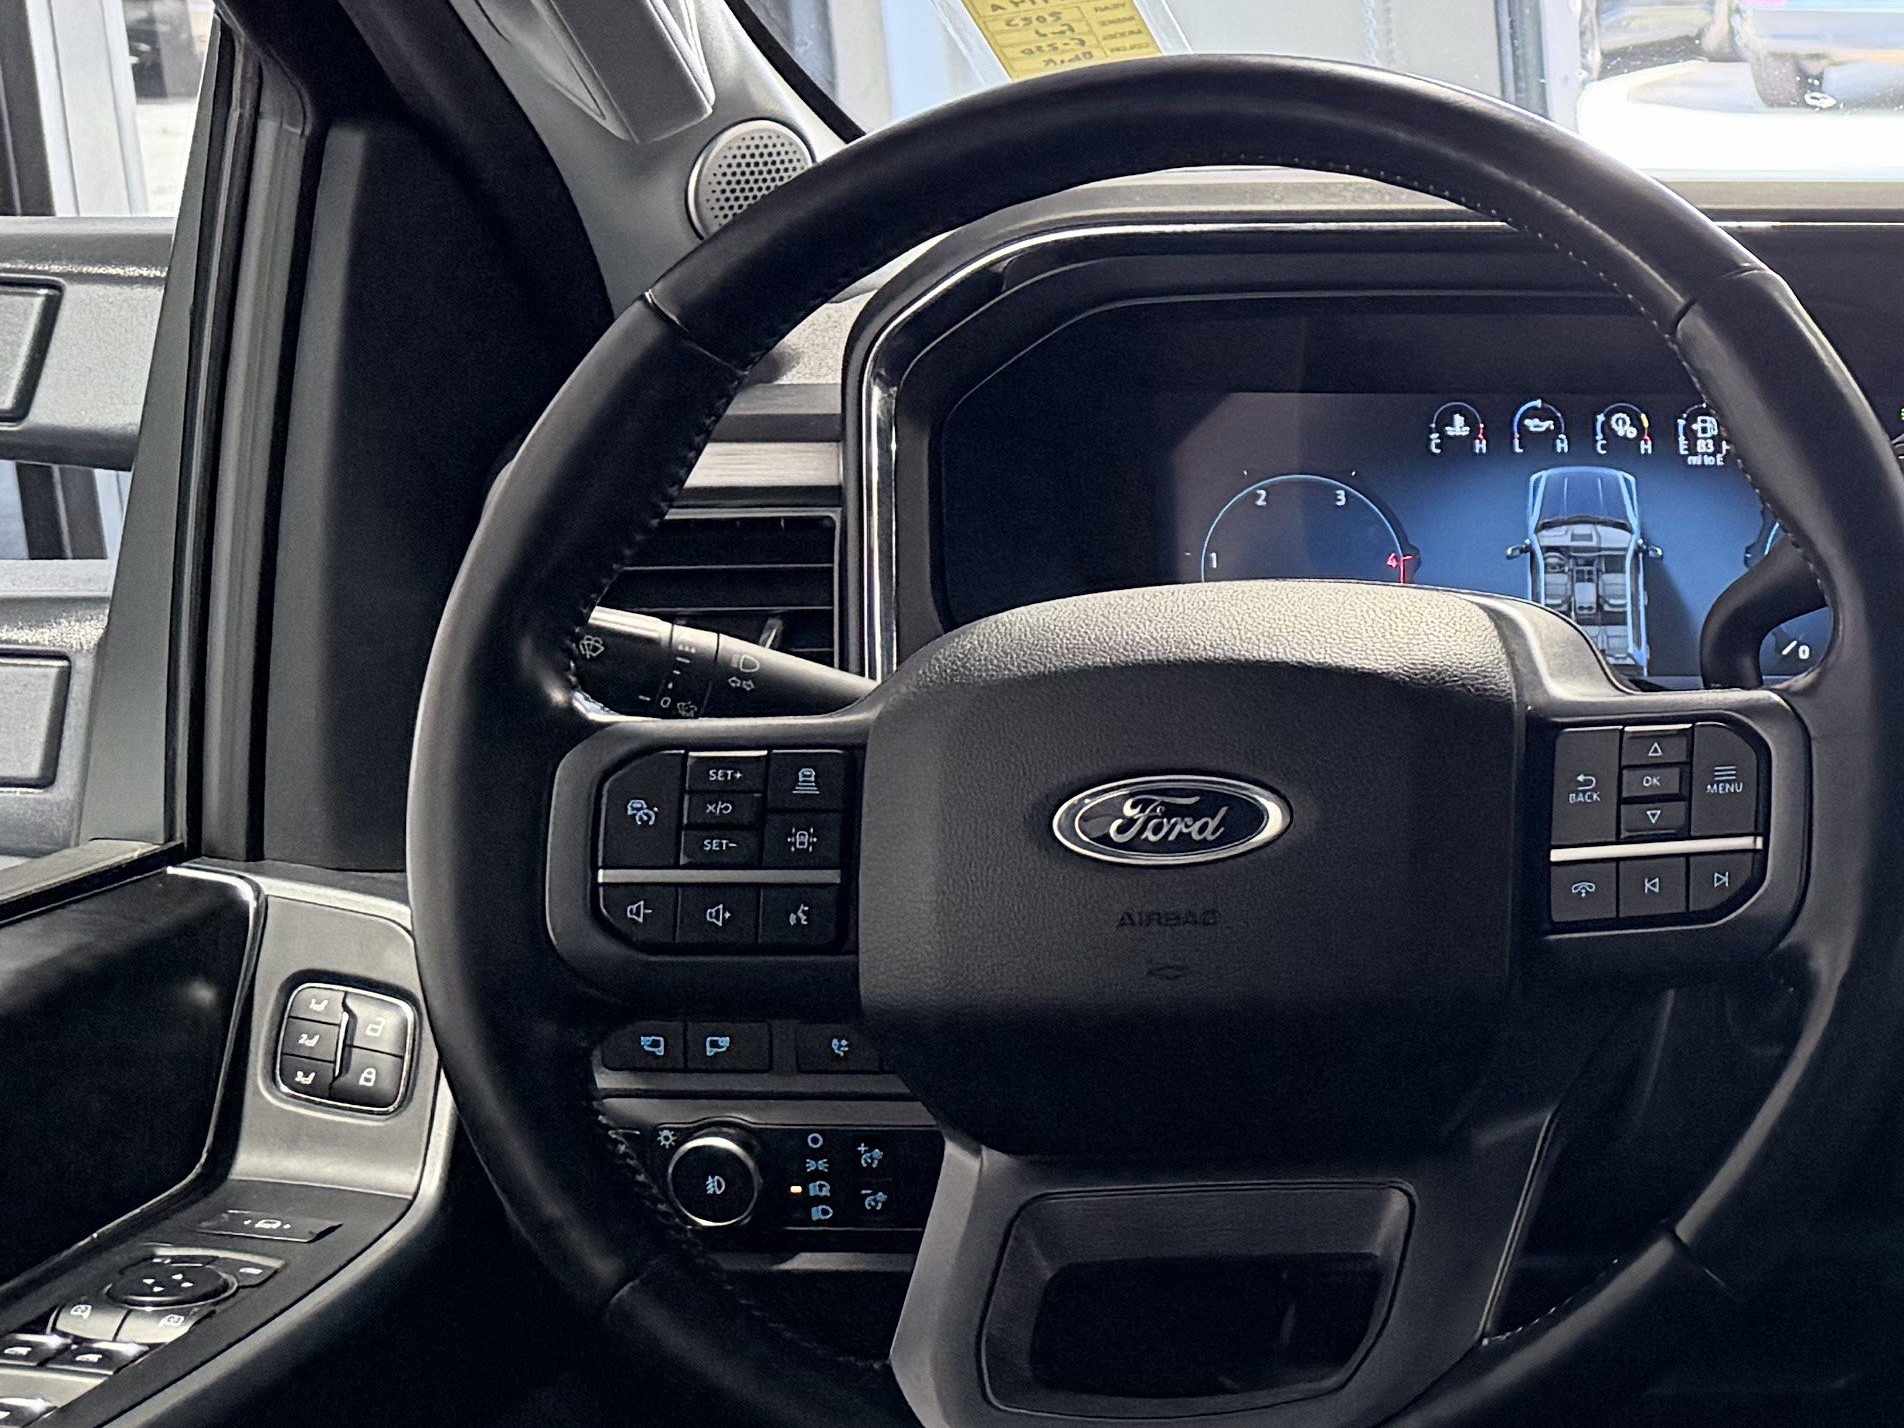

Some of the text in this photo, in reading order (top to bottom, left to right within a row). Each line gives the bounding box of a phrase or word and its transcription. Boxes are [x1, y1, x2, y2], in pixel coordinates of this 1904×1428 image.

[1430, 439, 1487, 454] C H
[1514, 439, 1524, 453] L
[1596, 439, 1652, 455] C H
[1679, 439, 1689, 454] E
[1255, 489, 1267, 506] 2
[1335, 489, 1347, 506] 3
[1209, 551, 1218, 570] 1
[1386, 552, 1399, 568] 4
[1798, 644, 1810, 660] 0
[1642, 775, 1661, 788] OK
[1706, 782, 1744, 795] MENU
[1568, 791, 1601, 804] BACK
[1109, 793, 1230, 843] Ford
